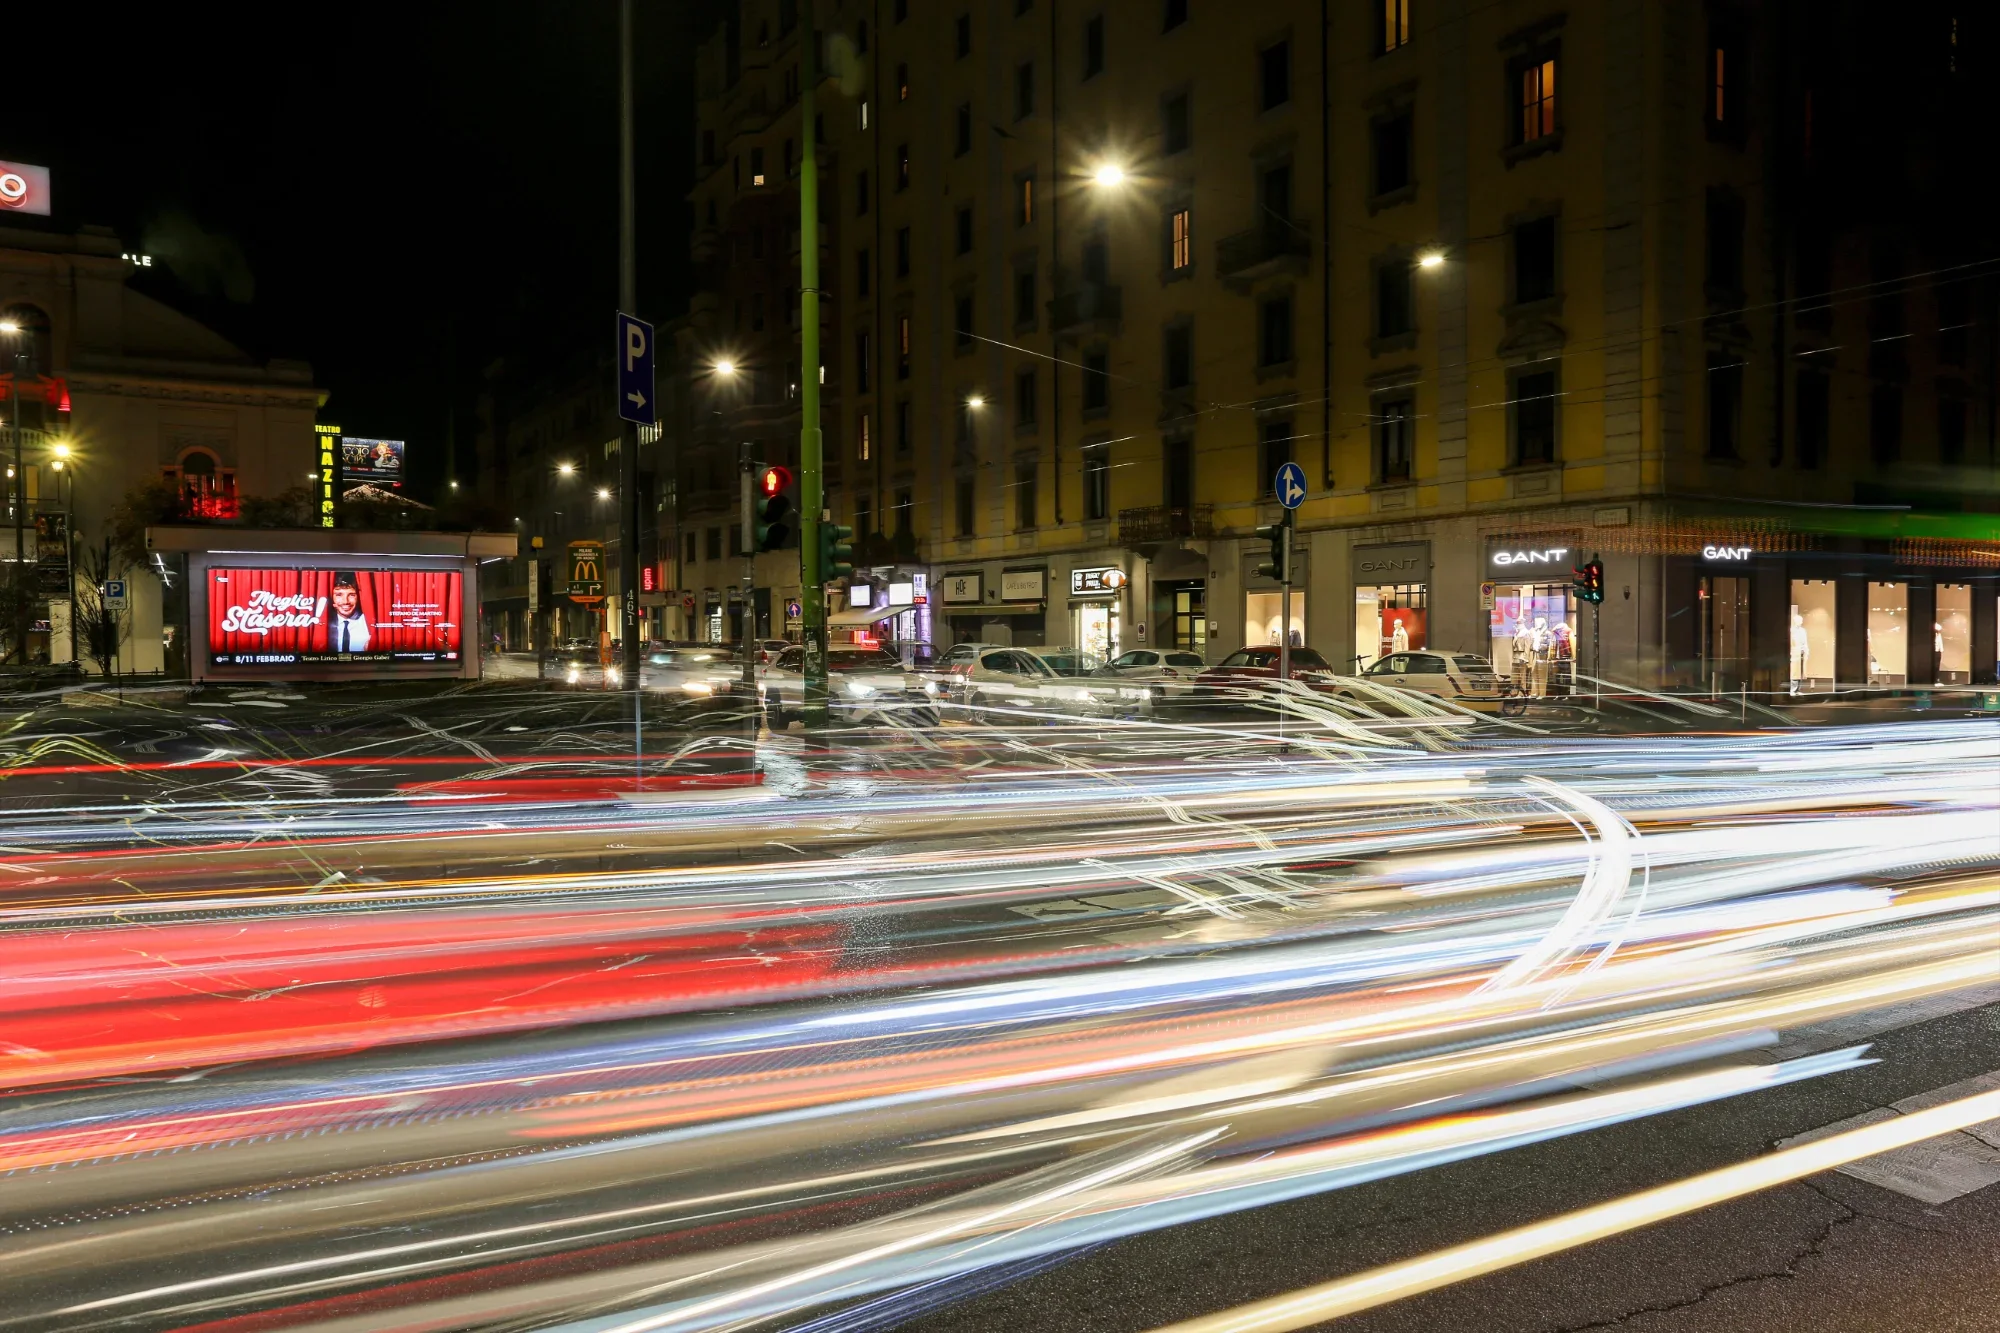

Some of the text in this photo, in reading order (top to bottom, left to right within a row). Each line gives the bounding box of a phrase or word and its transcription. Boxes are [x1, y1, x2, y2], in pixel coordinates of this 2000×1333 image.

[626, 322, 646, 373] P
[314, 425, 341, 433] TEATRO
[1493, 548, 1568, 566] GANT
[1703, 545, 1752, 560] GANT
[1359, 558, 1418, 572] GANT
[644, 567, 653, 591] upim
[110, 584, 120, 595] P
[248, 590, 315, 611] Meglio
[235, 655, 254, 665] 8/11
[256, 655, 295, 663] FEBBRAIO
